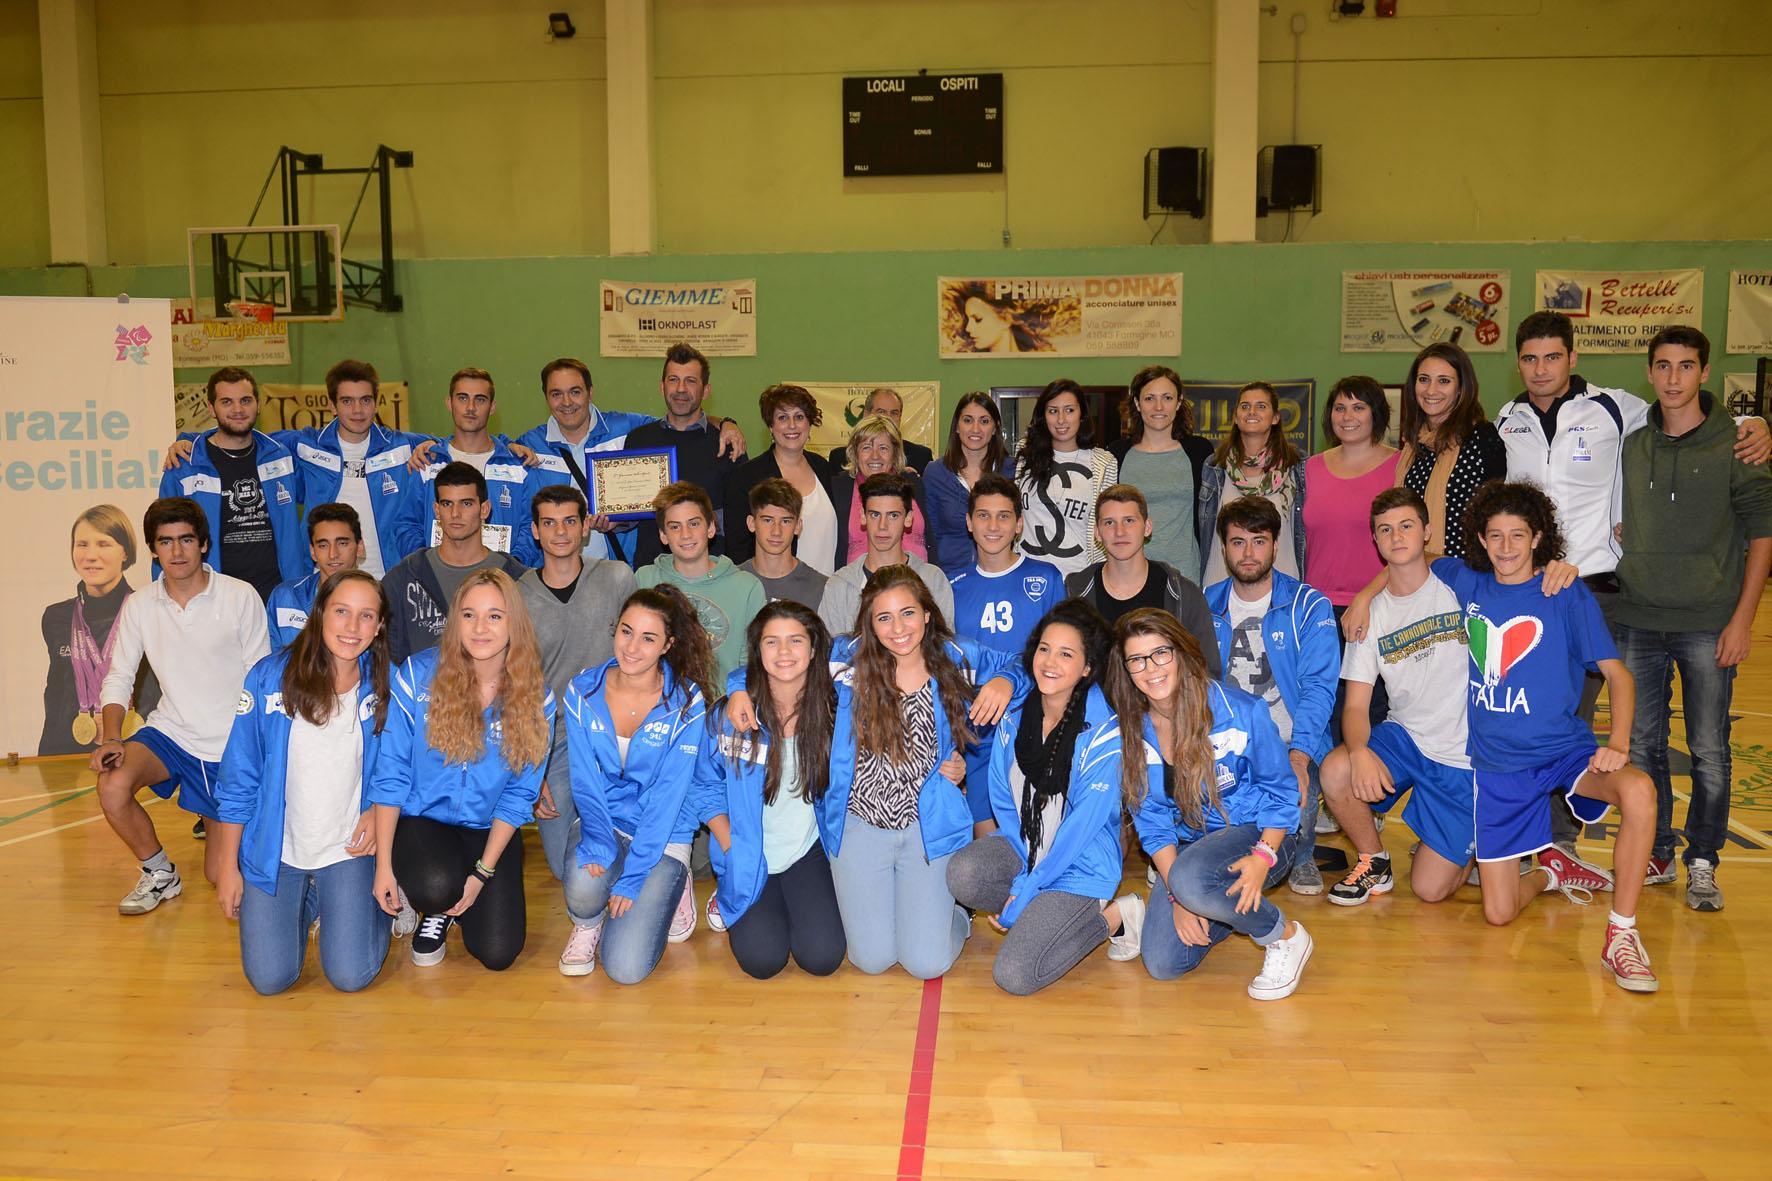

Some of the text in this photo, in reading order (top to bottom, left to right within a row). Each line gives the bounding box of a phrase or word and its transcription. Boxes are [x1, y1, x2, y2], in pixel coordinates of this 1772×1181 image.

[867, 80, 904, 92] LOCALI
[940, 78, 978, 91] OSPITI
[1738, 274, 1772, 286] HOT
[995, 278, 1177, 300] PRIMA DONNA
[1601, 279, 1679, 297] Bettelli
[625, 288, 723, 305] GIEMME
[1086, 299, 1177, 308] acconciature unisex
[1600, 300, 1674, 318] Recuperi
[658, 320, 718, 330] OKNOPLAST
[1573, 326, 1637, 335] ALTIMENTO
[1577, 338, 1630, 347] FORMIGINE
[0, 400, 130, 441] razie
[1064, 498, 1088, 520] TEE
[980, 600, 1014, 634] 43
[1444, 613, 1461, 628] CUP
